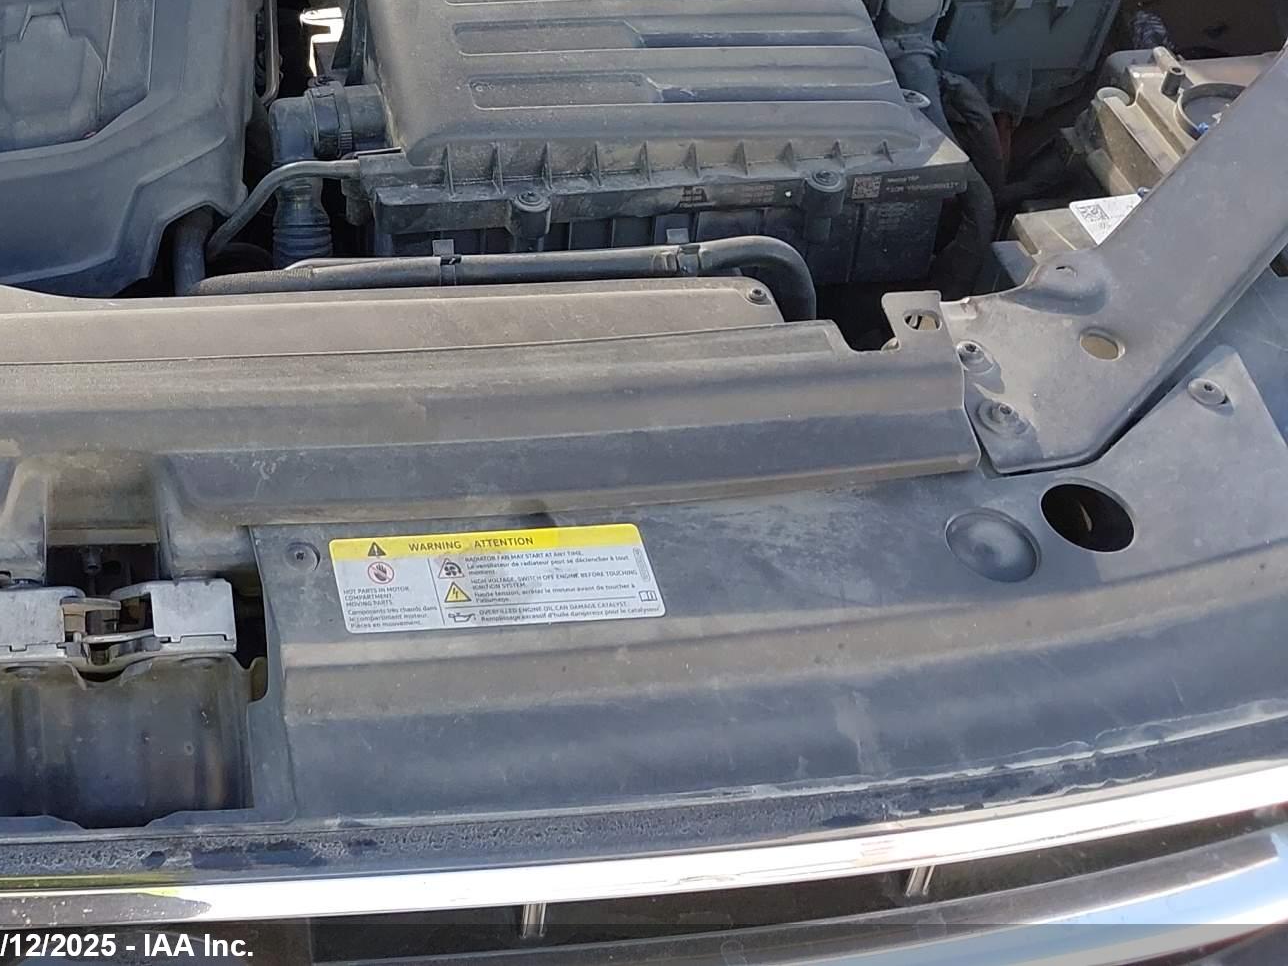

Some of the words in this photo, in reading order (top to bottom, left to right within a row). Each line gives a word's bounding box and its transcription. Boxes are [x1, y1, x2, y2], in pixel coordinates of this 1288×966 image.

[409, 541, 462, 552] WARNING
[474, 537, 534, 548] ATTENTION
[605, 570, 638, 578] TOUCHING
[478, 608, 518, 616] OVERFILLED
